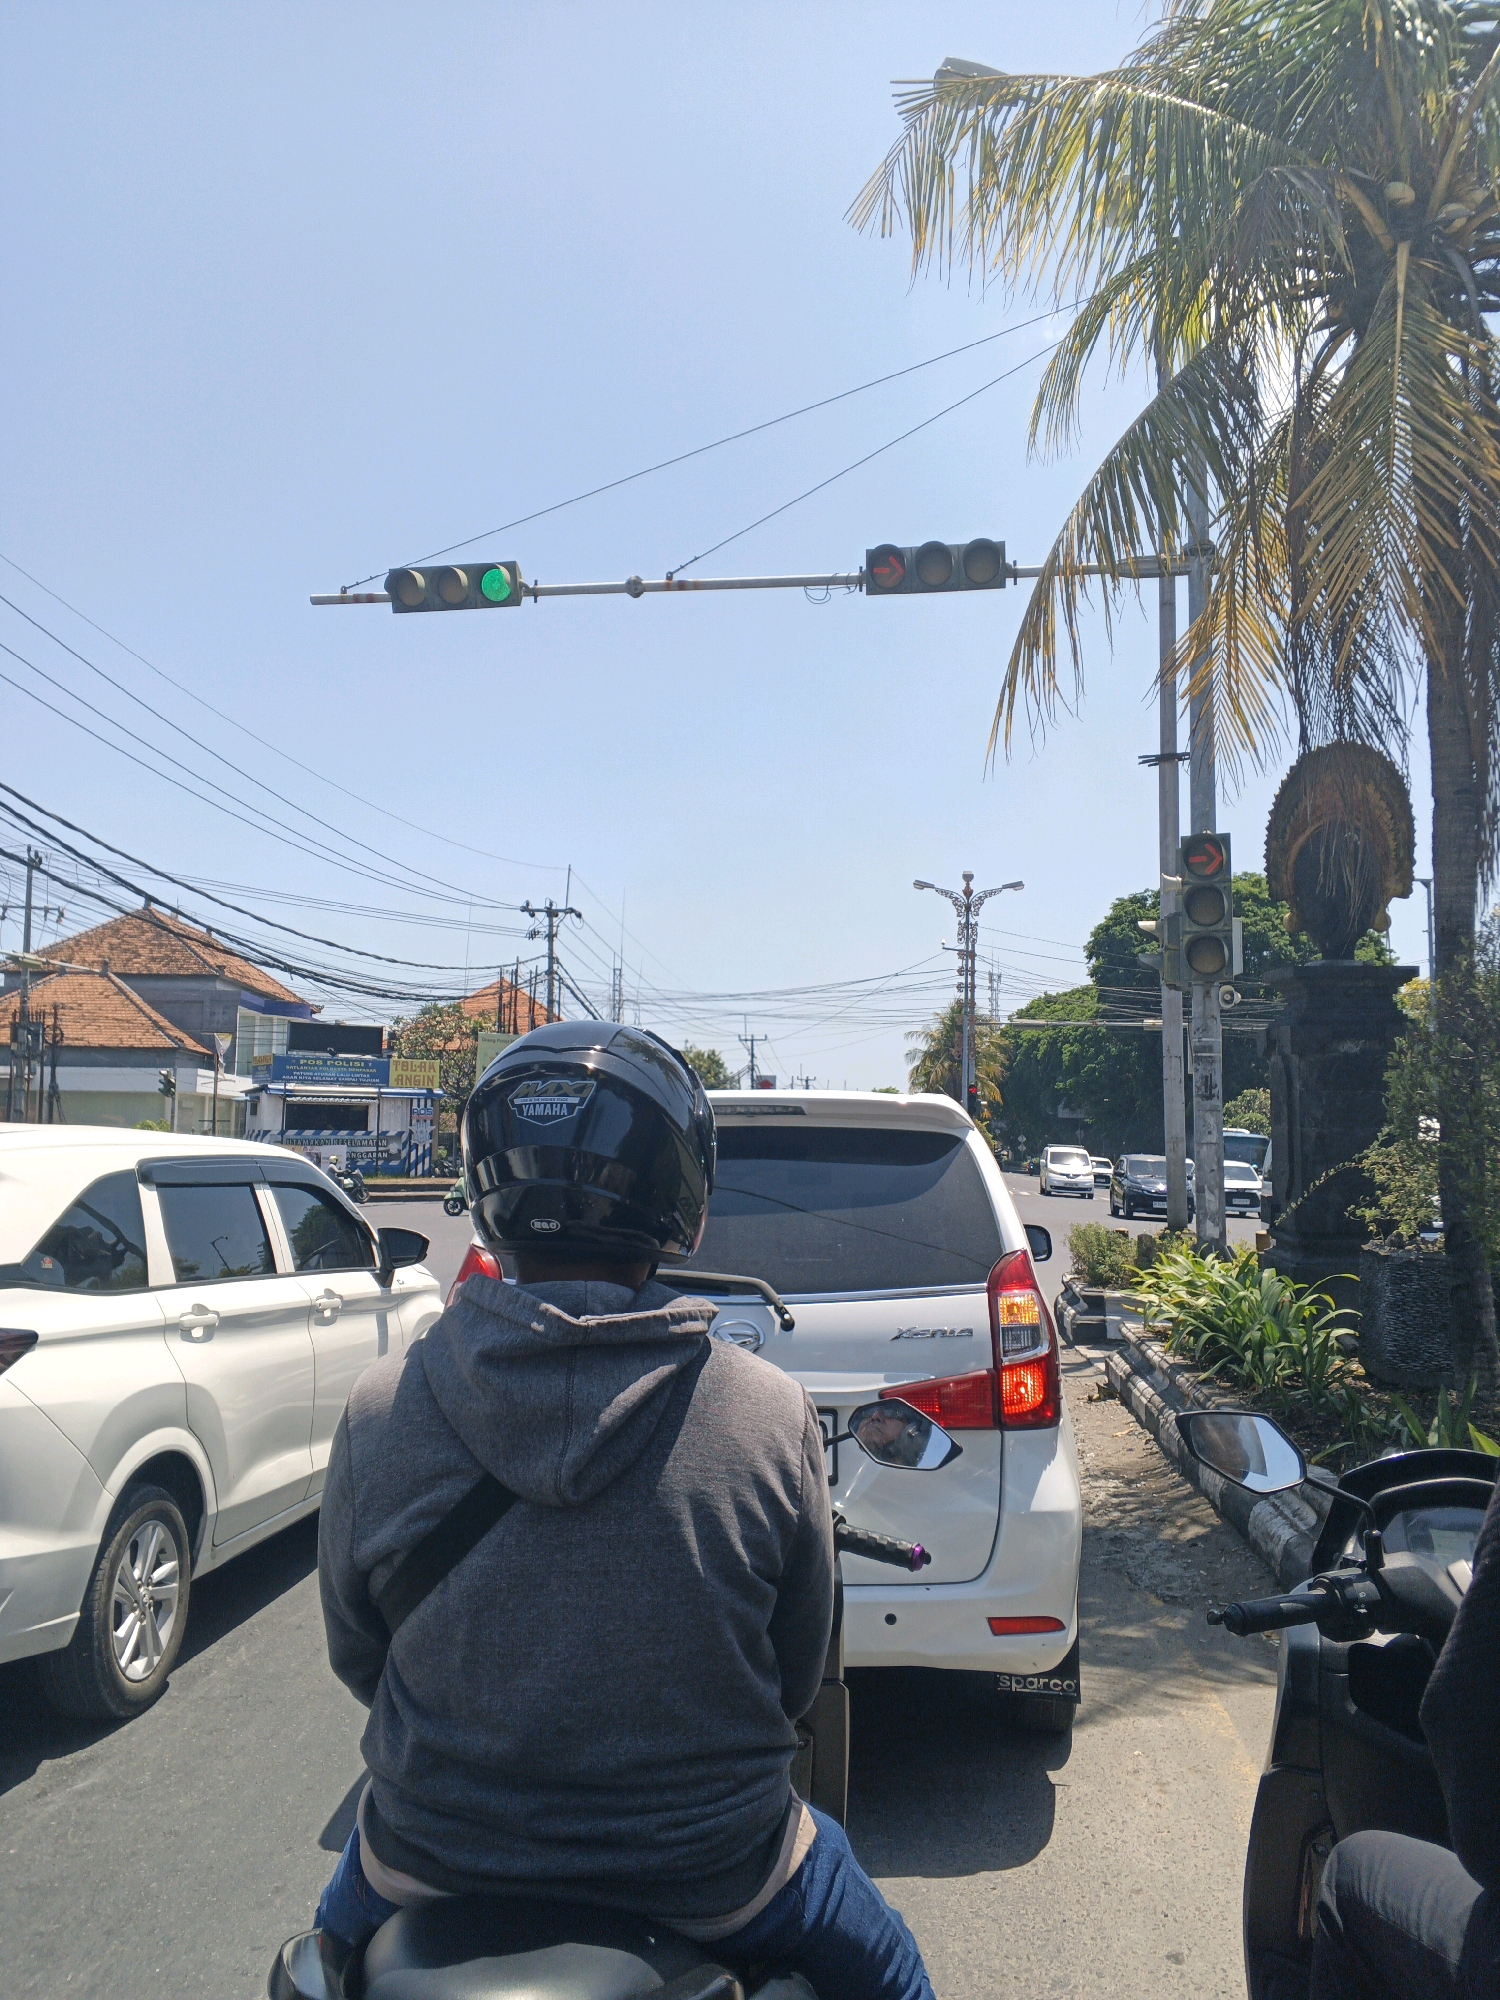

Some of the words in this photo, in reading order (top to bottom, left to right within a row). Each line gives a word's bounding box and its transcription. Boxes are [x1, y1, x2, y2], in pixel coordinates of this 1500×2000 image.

[392, 1060, 436, 1073] TOLAK
[395, 1073, 435, 1086] ANGIN
[412, 1108, 433, 1116] POS
[522, 1103, 568, 1116] YAMAHA
[285, 1138, 331, 1146] UTAMAKAN
[347, 1151, 388, 1159] ANGGARAN
[998, 1675, 1076, 1692] sparco
